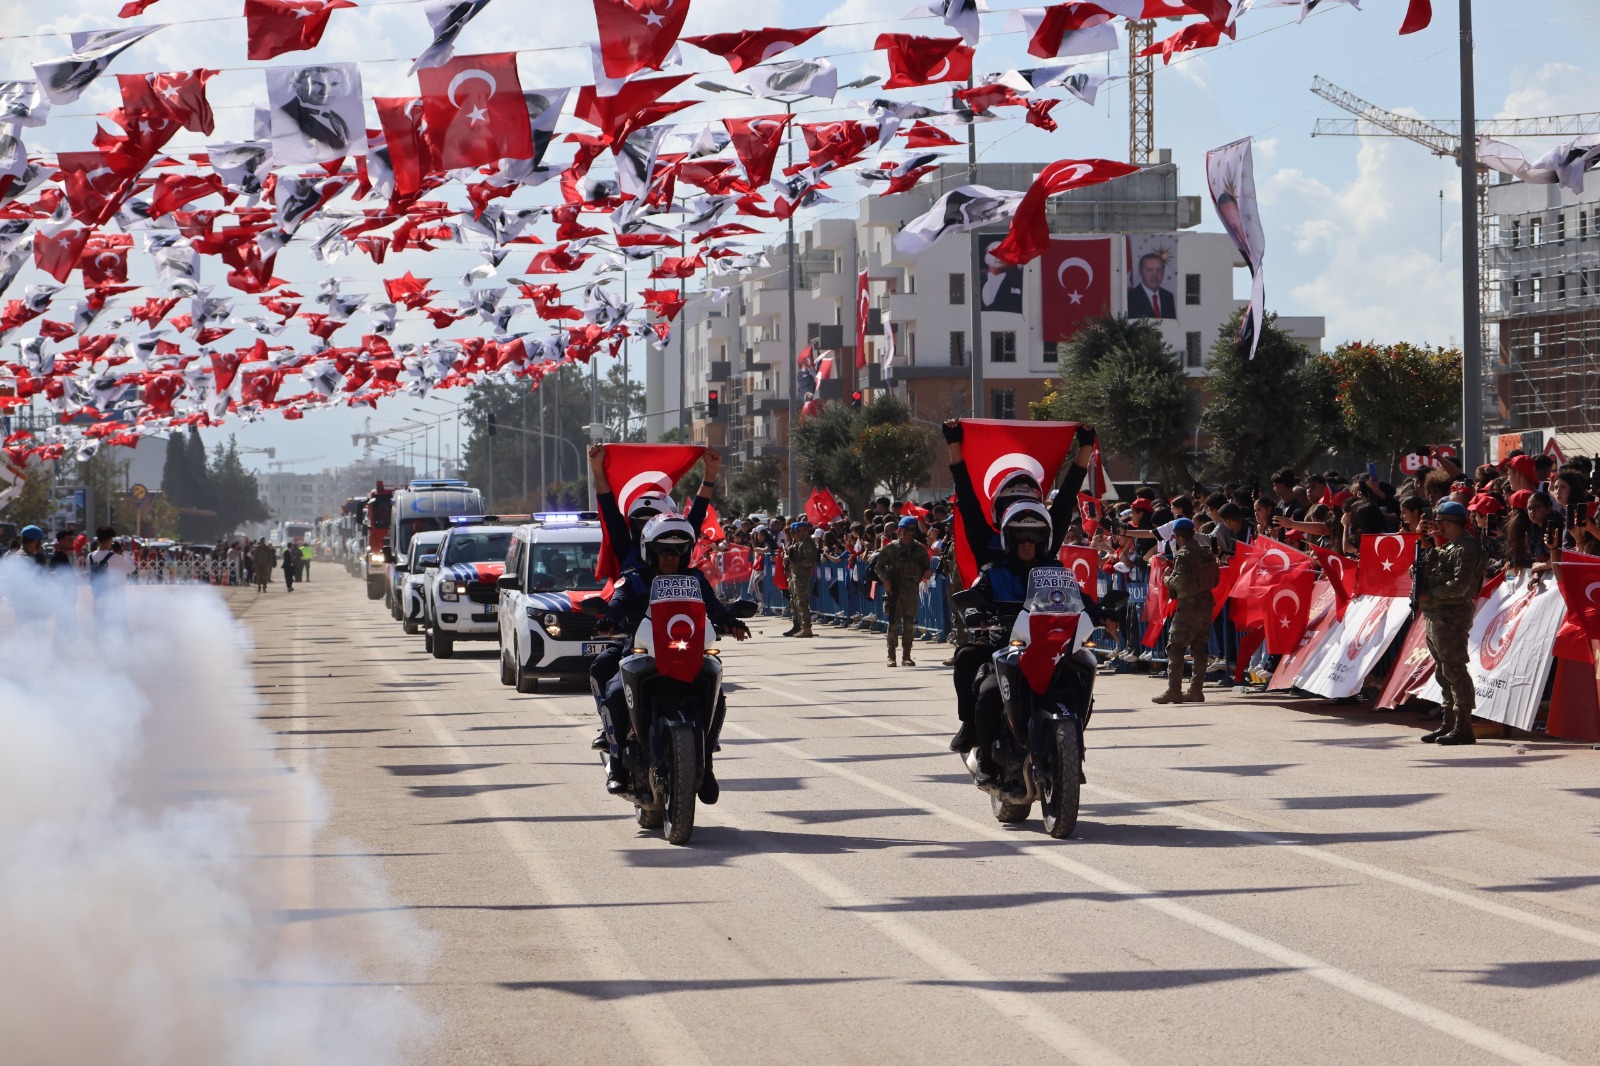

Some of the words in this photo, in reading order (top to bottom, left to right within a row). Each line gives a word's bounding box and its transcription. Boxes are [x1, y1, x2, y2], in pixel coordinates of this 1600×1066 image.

[656, 578, 698, 588] TRAFİK
[1035, 578, 1076, 590] ZABITA
[657, 588, 700, 599] ZABITA
[1128, 585, 1149, 599] POLİ
[587, 644, 596, 653] 31
